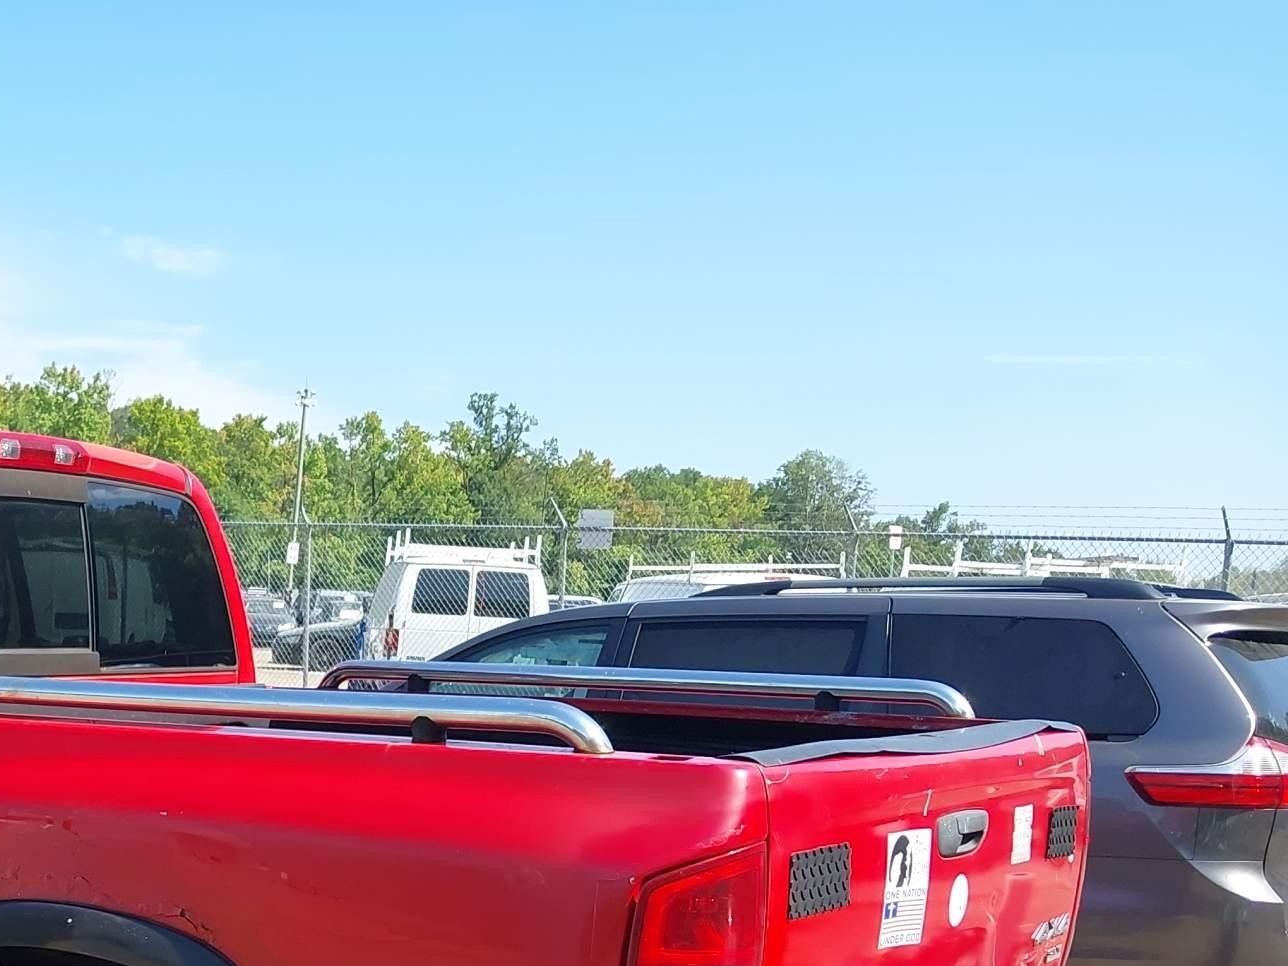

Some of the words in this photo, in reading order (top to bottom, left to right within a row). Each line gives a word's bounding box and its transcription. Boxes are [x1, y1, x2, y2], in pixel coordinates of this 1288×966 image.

[885, 889, 901, 901] ONE
[903, 887, 927, 898] NATION
[879, 933, 905, 947] UNDER
[905, 932, 921, 943] GOD
